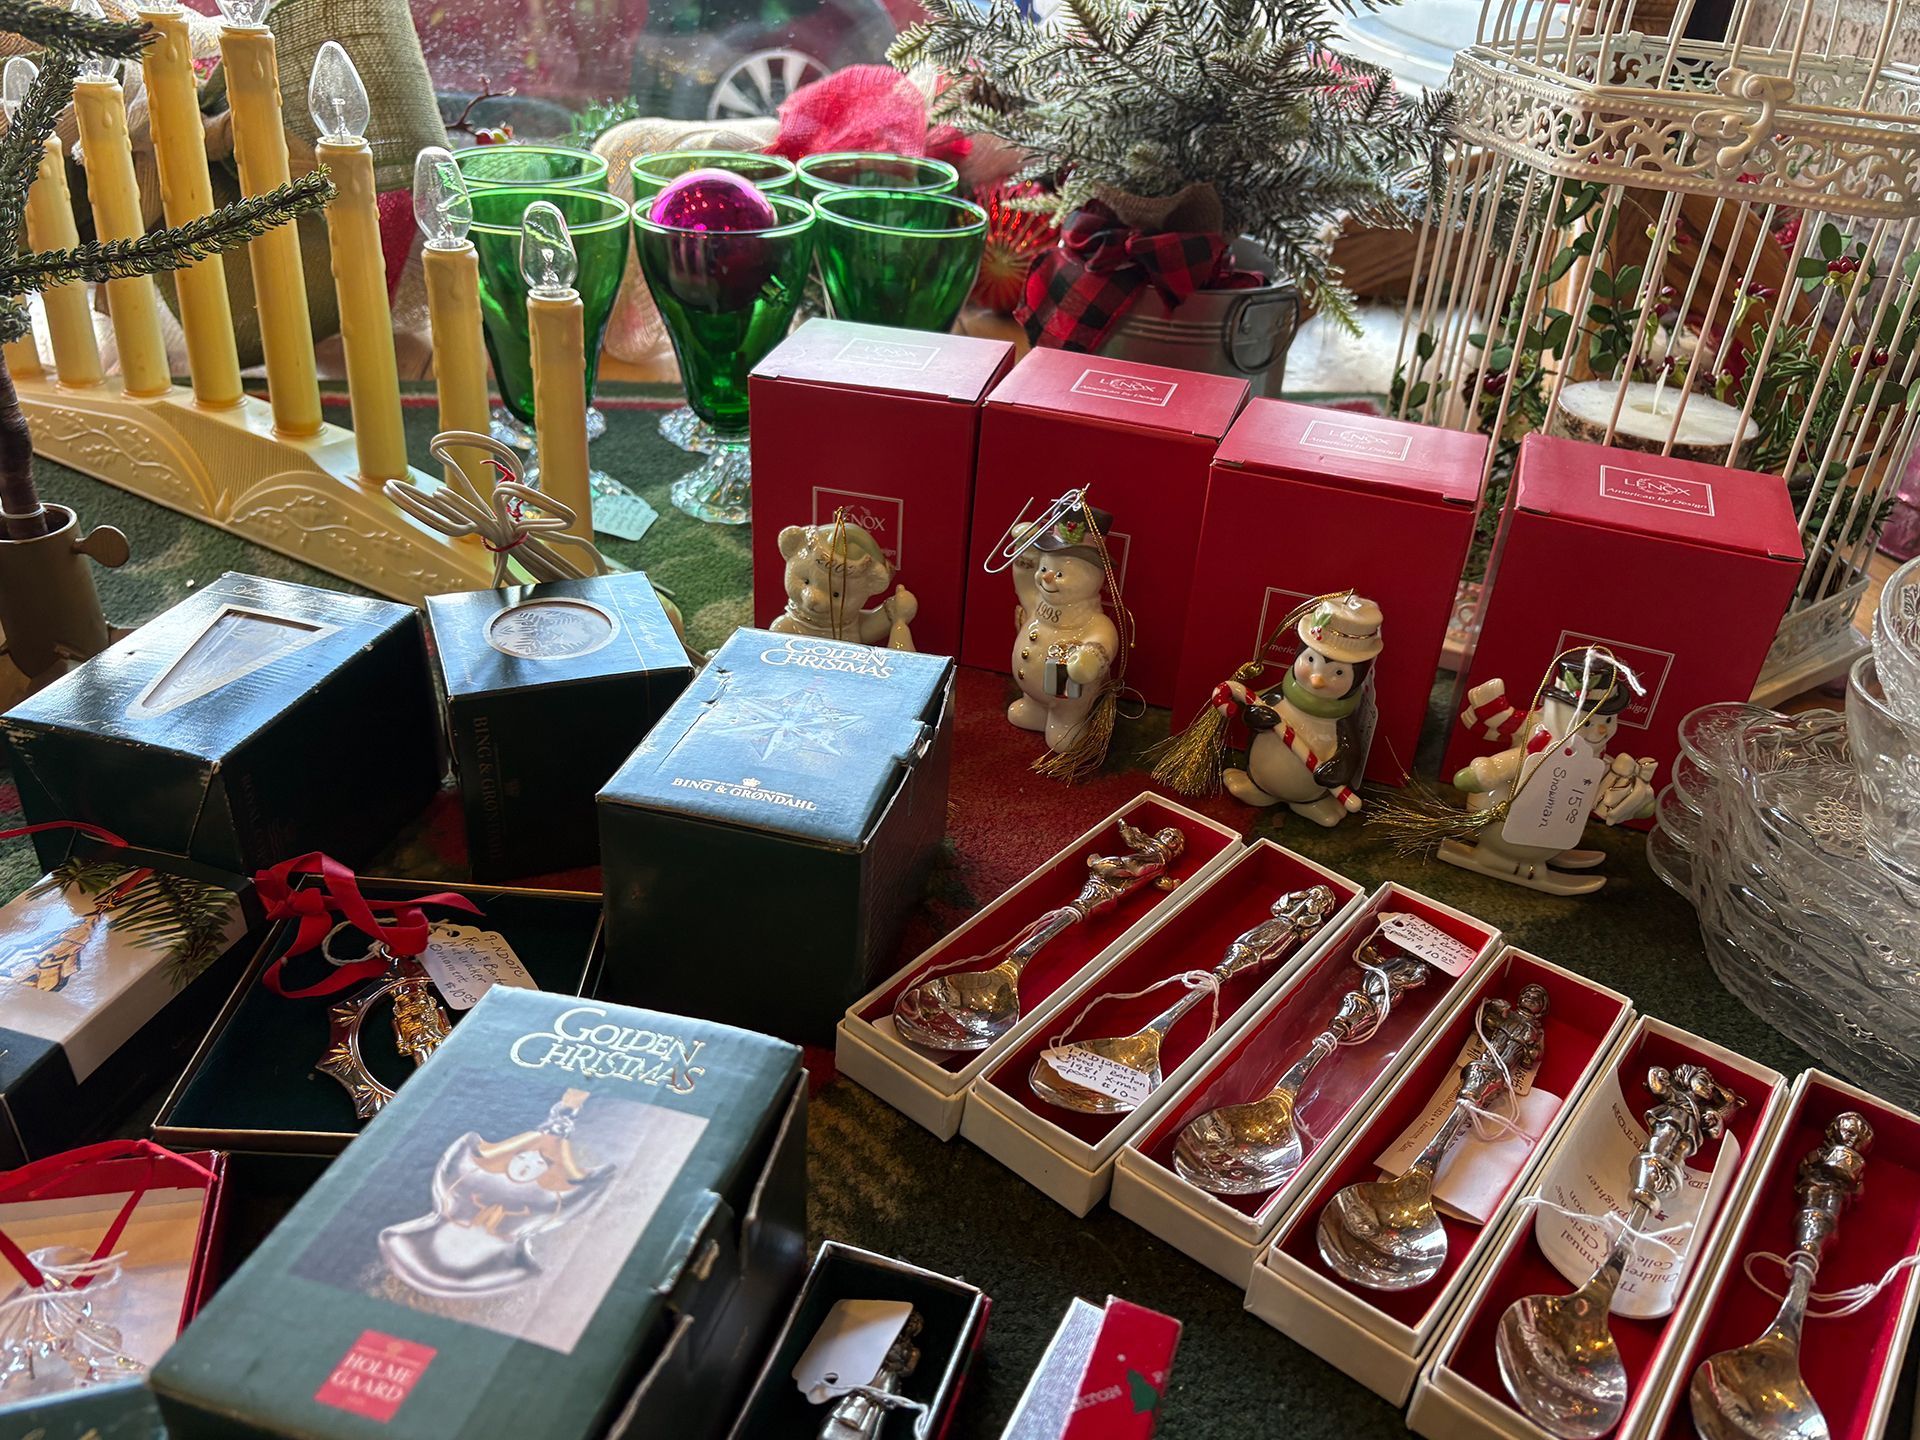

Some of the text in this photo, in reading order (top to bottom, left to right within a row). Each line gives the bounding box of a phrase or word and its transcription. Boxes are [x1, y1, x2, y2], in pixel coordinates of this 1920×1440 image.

[1099, 377, 1157, 393] LENOX
[1606, 488, 1656, 500] American
[1672, 499, 1708, 509] Design
[1624, 478, 1691, 497] LENOX
[1036, 601, 1062, 623] 1998
[760, 648, 894, 679] CHRISTMAS
[784, 638, 889, 667] GOLDEN
[671, 777, 817, 811] BING & GRØNDAHL
[1537, 766, 1567, 828] Snowman
[554, 1007, 706, 1066] GOLDEN
[510, 1032, 706, 1096] CHRISTMAS
[1109, 1069, 1147, 1088] Barton
[344, 1351, 413, 1385] HOLME
[331, 1370, 405, 1402] GAARD
